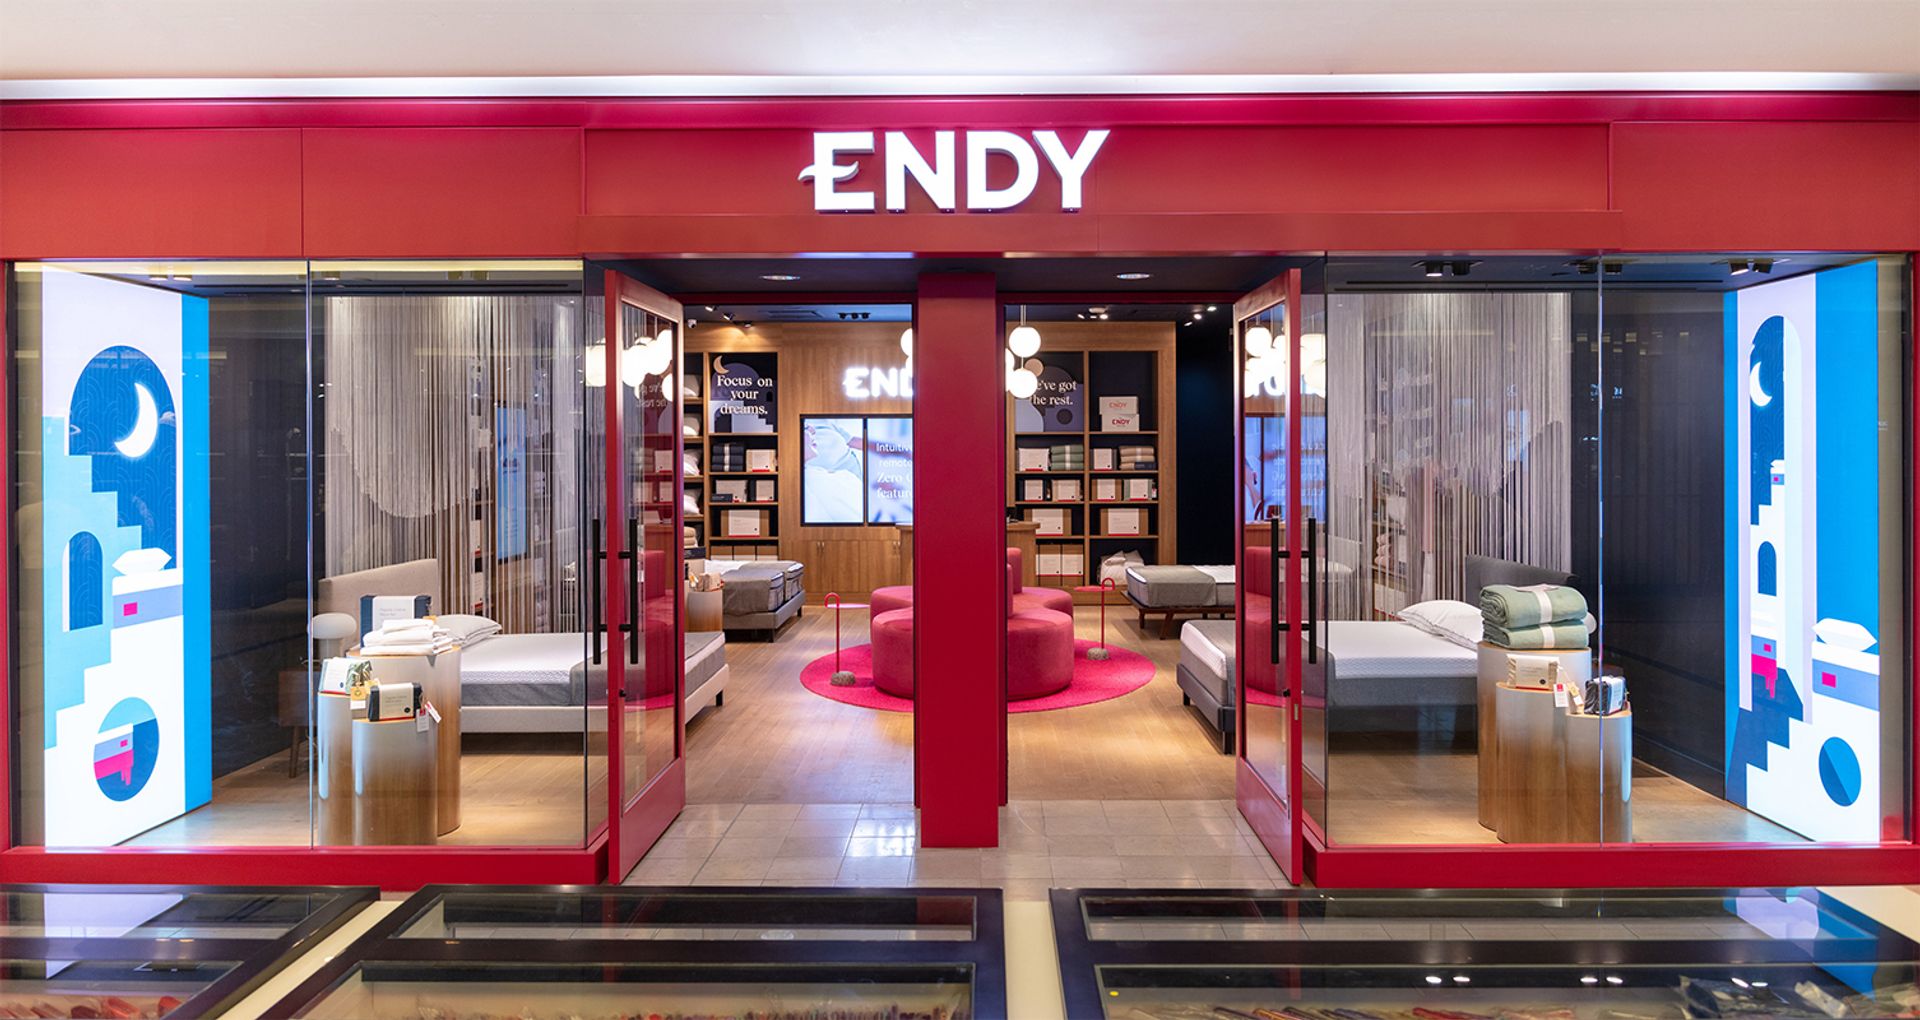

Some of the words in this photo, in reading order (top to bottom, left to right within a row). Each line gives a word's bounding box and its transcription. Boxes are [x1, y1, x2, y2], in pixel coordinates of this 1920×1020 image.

[798, 129, 1111, 213] ENDY
[717, 375, 753, 387] Focus
[757, 378, 773, 387] on
[1036, 380, 1056, 391] e've
[1058, 381, 1077, 393] got
[730, 390, 759, 401] your
[1049, 395, 1074, 406] rest.
[720, 403, 768, 415] dreams.
